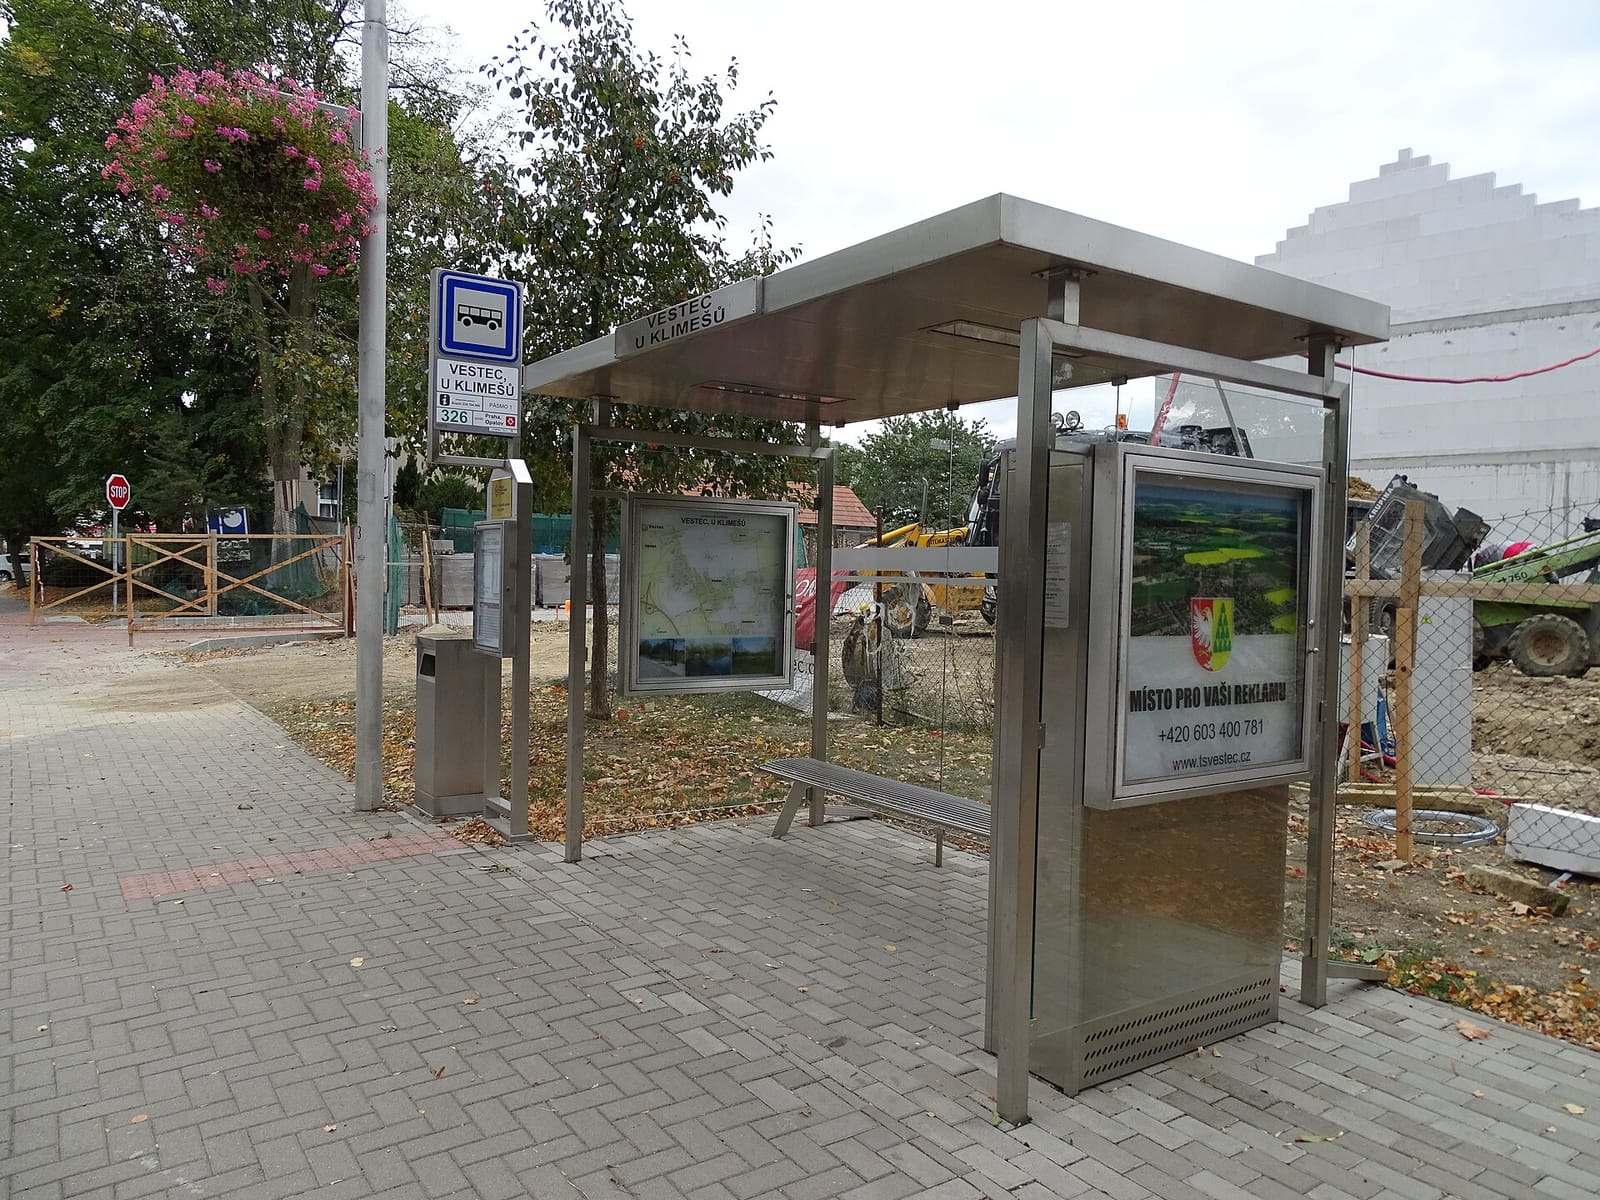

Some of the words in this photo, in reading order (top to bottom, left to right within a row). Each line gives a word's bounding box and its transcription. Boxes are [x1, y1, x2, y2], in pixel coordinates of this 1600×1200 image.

[647, 295, 712, 328] VESTEC
[635, 335, 645, 349] U
[650, 305, 726, 345] KLIMEŠŮ
[449, 363, 507, 382] VESTEC,
[441, 378, 450, 389] U
[455, 380, 514, 396] KLIMEŠŮ
[441, 409, 468, 424] 326
[110, 485, 128, 499] STOP
[681, 517, 709, 526] VESTEC,
[710, 518, 716, 526] U
[1129, 685, 1172, 713] MÍSTO
[1175, 686, 1201, 709] PRO
[1203, 681, 1232, 707] VAŠI
[1233, 681, 1286, 705] REKLAMU
[1158, 724, 1190, 744] +420
[1193, 722, 1216, 742] 603
[1218, 721, 1241, 739] 400
[1243, 718, 1264, 736] 781
[1171, 750, 1251, 771] www.tsvestec.cz
